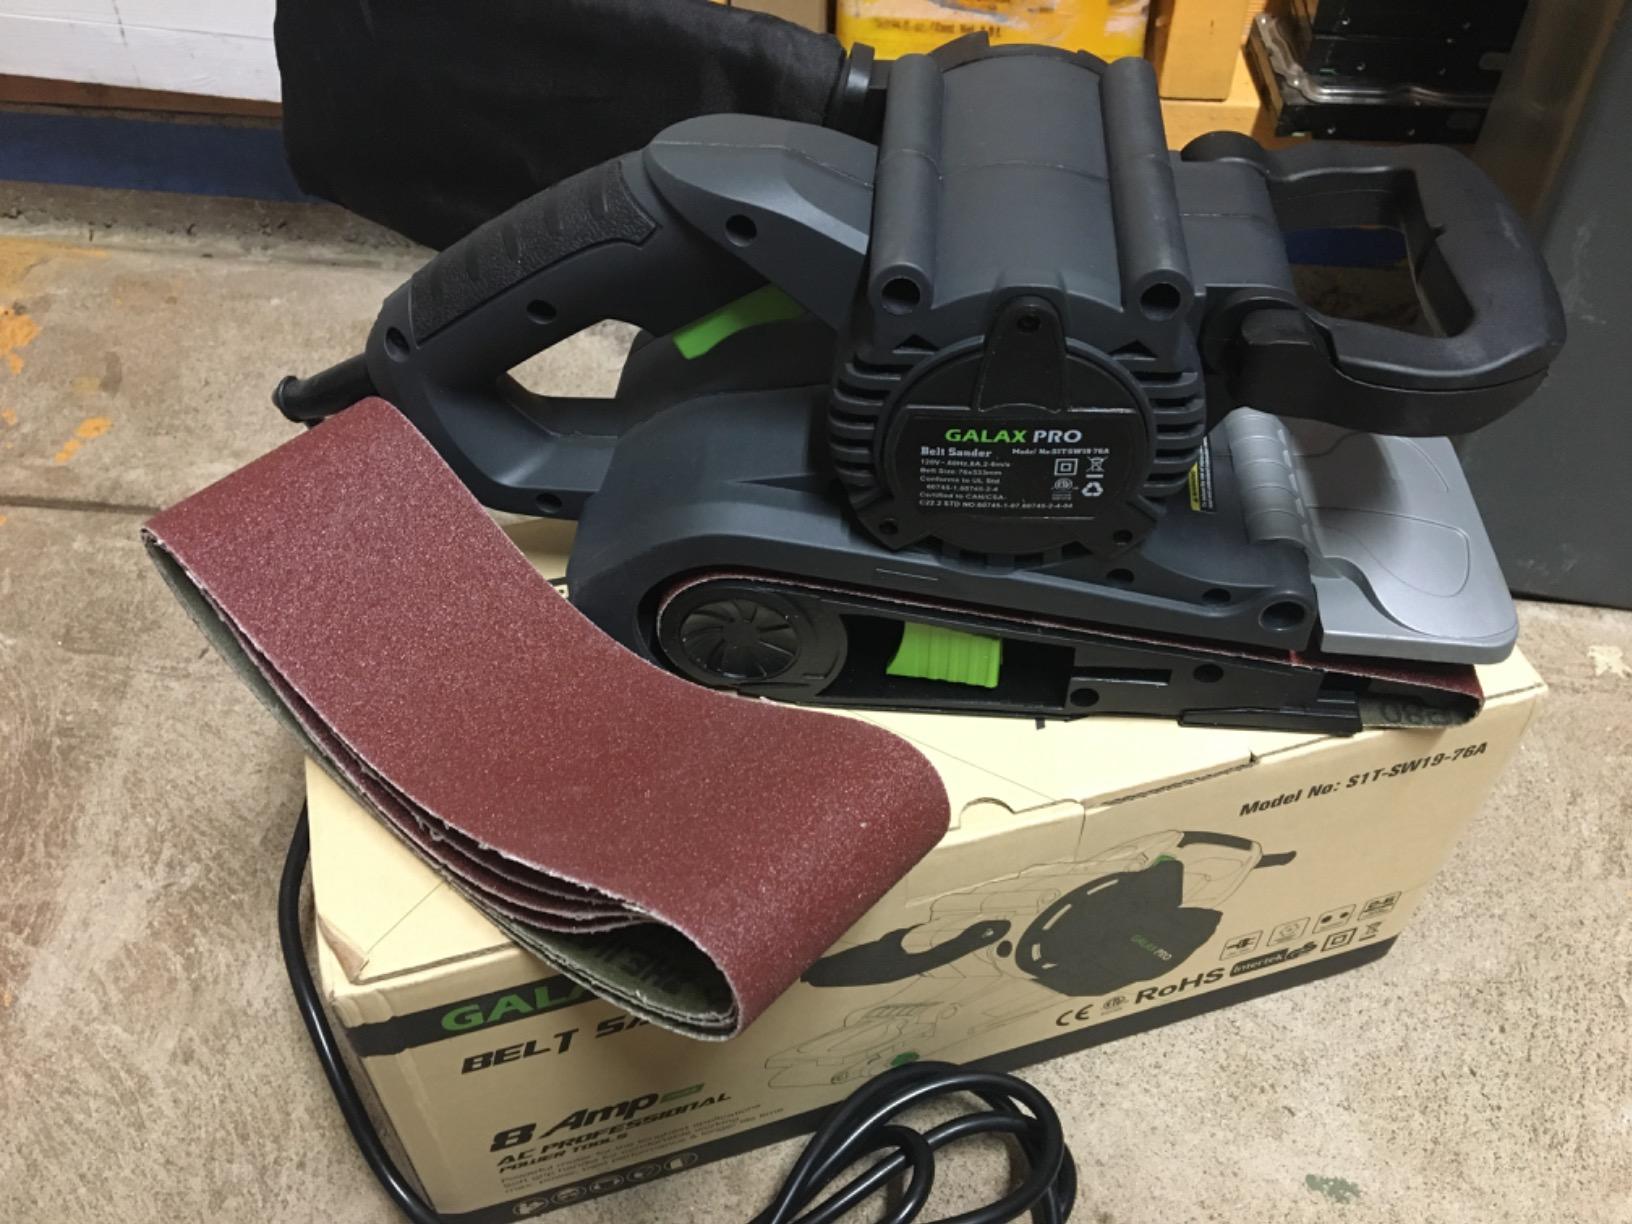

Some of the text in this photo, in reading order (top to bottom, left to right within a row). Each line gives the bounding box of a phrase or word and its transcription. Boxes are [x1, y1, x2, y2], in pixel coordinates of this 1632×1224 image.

[921, 446, 992, 457] Belt Sander
[944, 429, 1082, 443] GALAX PRO
[1239, 742, 1488, 816] Model No: S1T-SW19-76A
[1134, 967, 1224, 1004] RoHS
[461, 1028, 579, 1075] BELT
[490, 1123, 537, 1151] 8
[538, 1092, 659, 1139] Amp
[497, 1149, 536, 1166] AC
[542, 1092, 732, 1153] PROFESSIONAL
[499, 1150, 567, 1174] POWER
[573, 1133, 629, 1152] TOOLS
